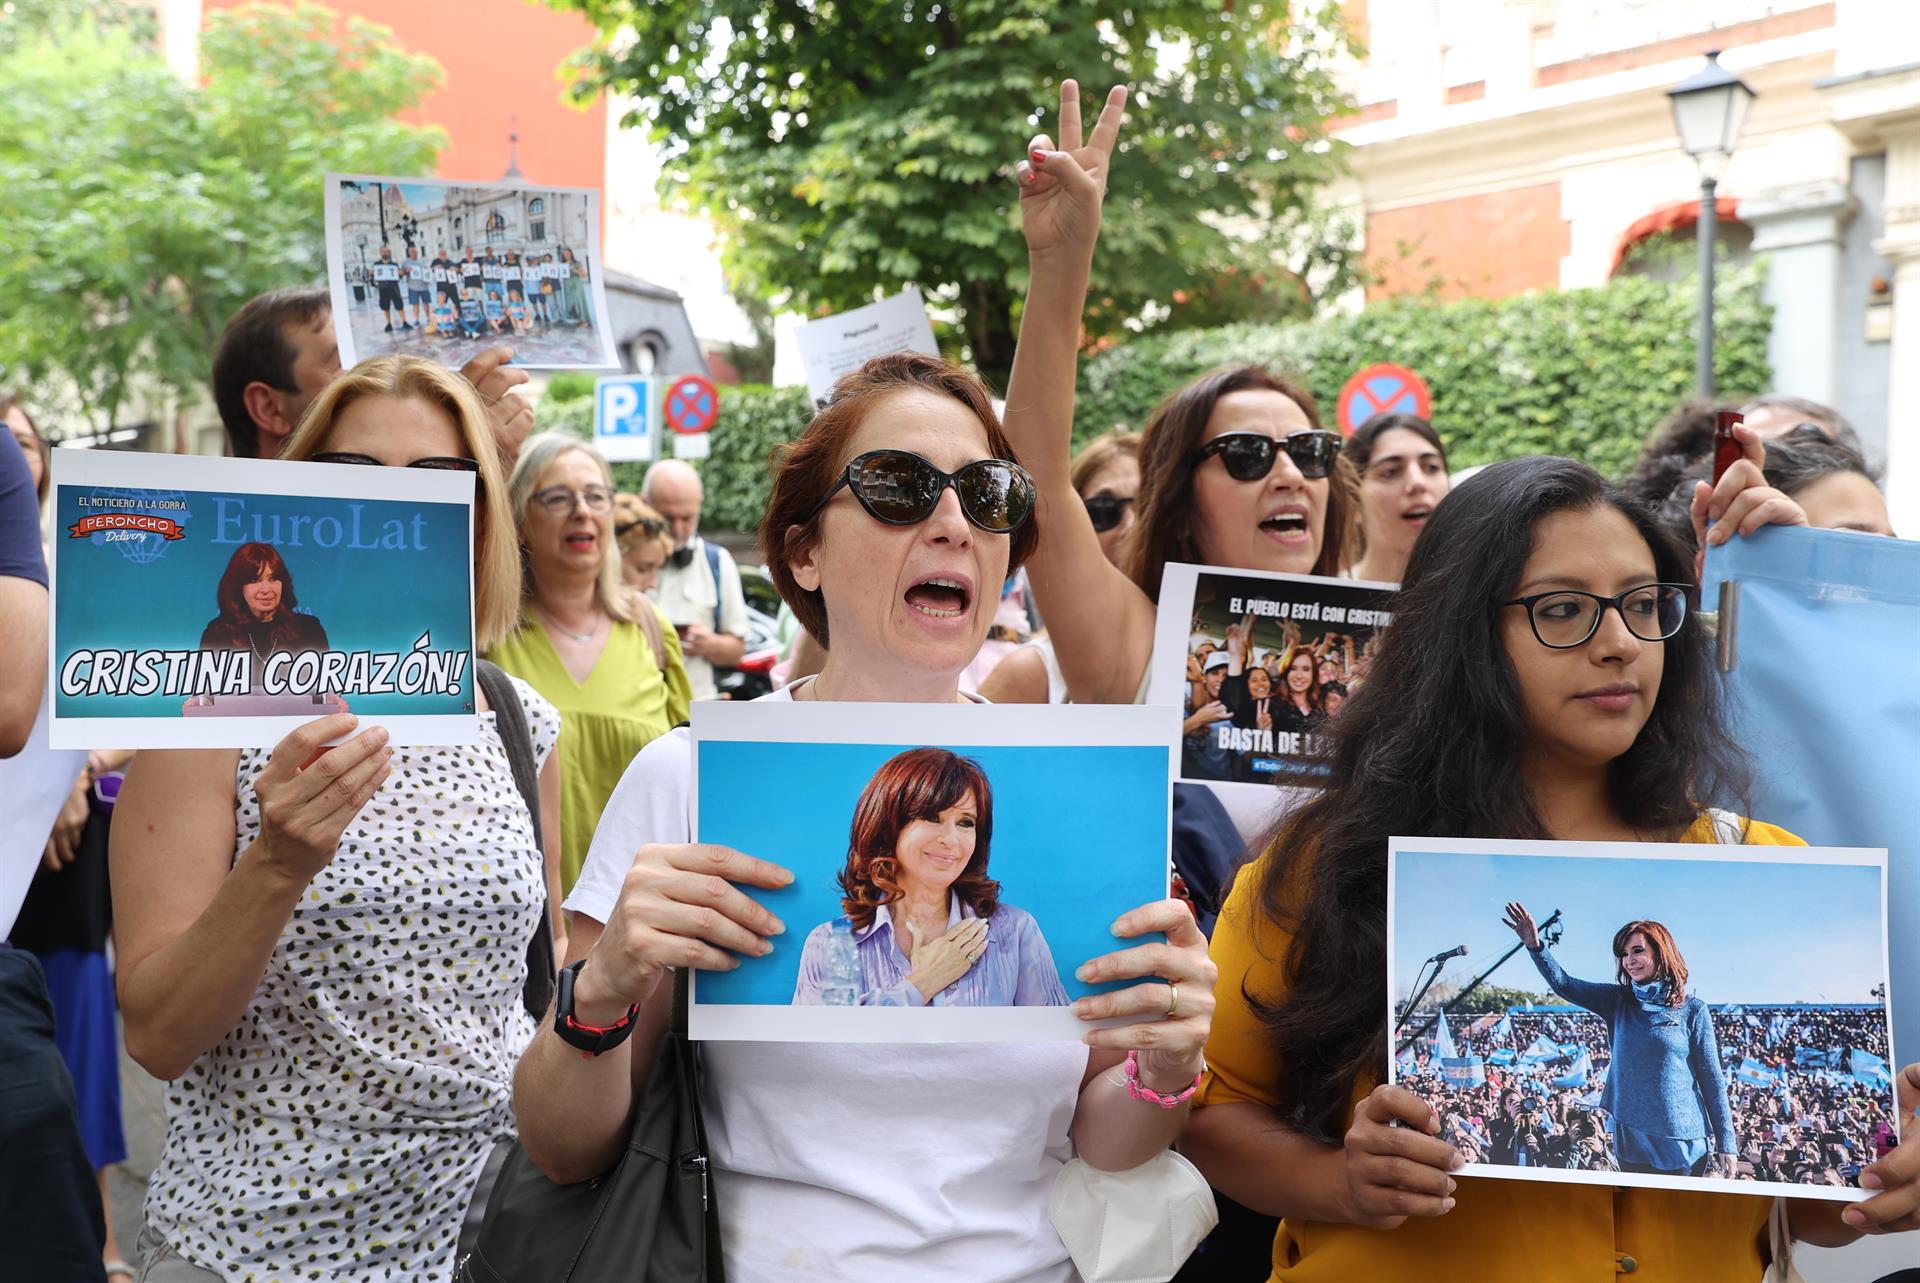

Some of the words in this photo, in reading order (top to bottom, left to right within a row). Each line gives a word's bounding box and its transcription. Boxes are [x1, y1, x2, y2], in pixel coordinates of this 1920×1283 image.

[603, 384, 638, 433] P
[78, 497, 89, 507] EL
[91, 497, 135, 508] NOTICIERO
[137, 499, 143, 509] A
[145, 500, 157, 509] LA
[159, 500, 187, 511] GORRA
[86, 516, 169, 531] PERONCHO
[105, 530, 148, 543] Delivery
[210, 497, 429, 551] EuroLat
[1229, 597, 1243, 614] EL
[1246, 599, 1290, 618] PUEBLO
[1291, 602, 1319, 620] ESTÁ
[1321, 606, 1345, 623] CON
[1347, 608, 1393, 627] CRISTIN
[60, 648, 253, 697] CRISTINA
[262, 629, 470, 697] CORAZÓN!
[1218, 726, 1273, 753] BASTA
[1278, 731, 1300, 755] DE
